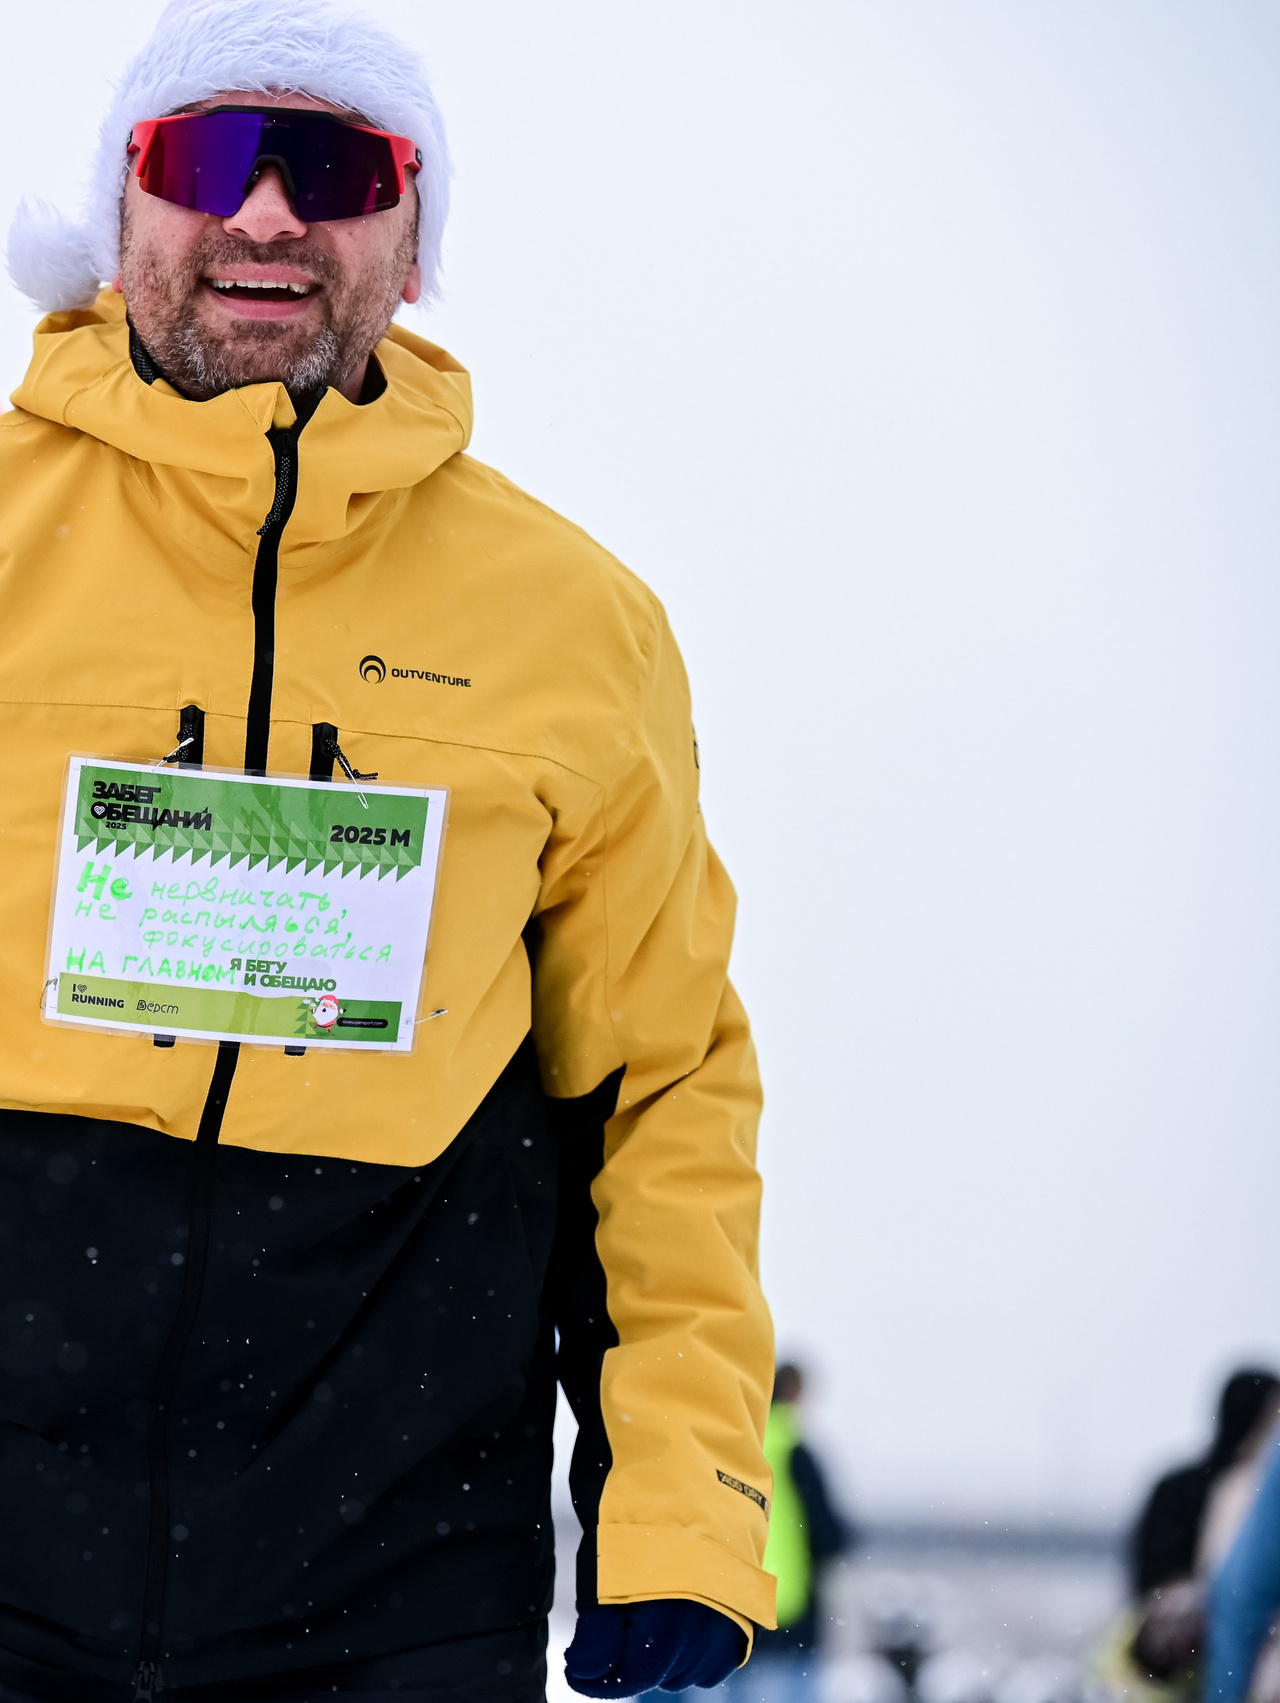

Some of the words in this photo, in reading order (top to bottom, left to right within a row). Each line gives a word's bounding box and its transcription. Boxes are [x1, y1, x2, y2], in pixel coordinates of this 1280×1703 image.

[391, 668, 471, 687] OUTVENTURE
[92, 780, 161, 804] ЗАБЕГ
[91, 801, 212, 831] ОБЕЩАНИЙ
[105, 821, 127, 830] 2025
[330, 825, 387, 846] 2025
[76, 861, 133, 901] Не
[74, 900, 117, 920] не
[142, 930, 392, 963] фокусироваться
[66, 947, 106, 974] НА
[122, 955, 236, 985] ГЛАВНОМ
[229, 957, 242, 971] Я
[245, 959, 288, 975] БЕГУ
[72, 983, 77, 993] I
[244, 973, 257, 986] И
[260, 974, 337, 992] ОБЕЩАЮ
[71, 993, 125, 1009] RUNNING
